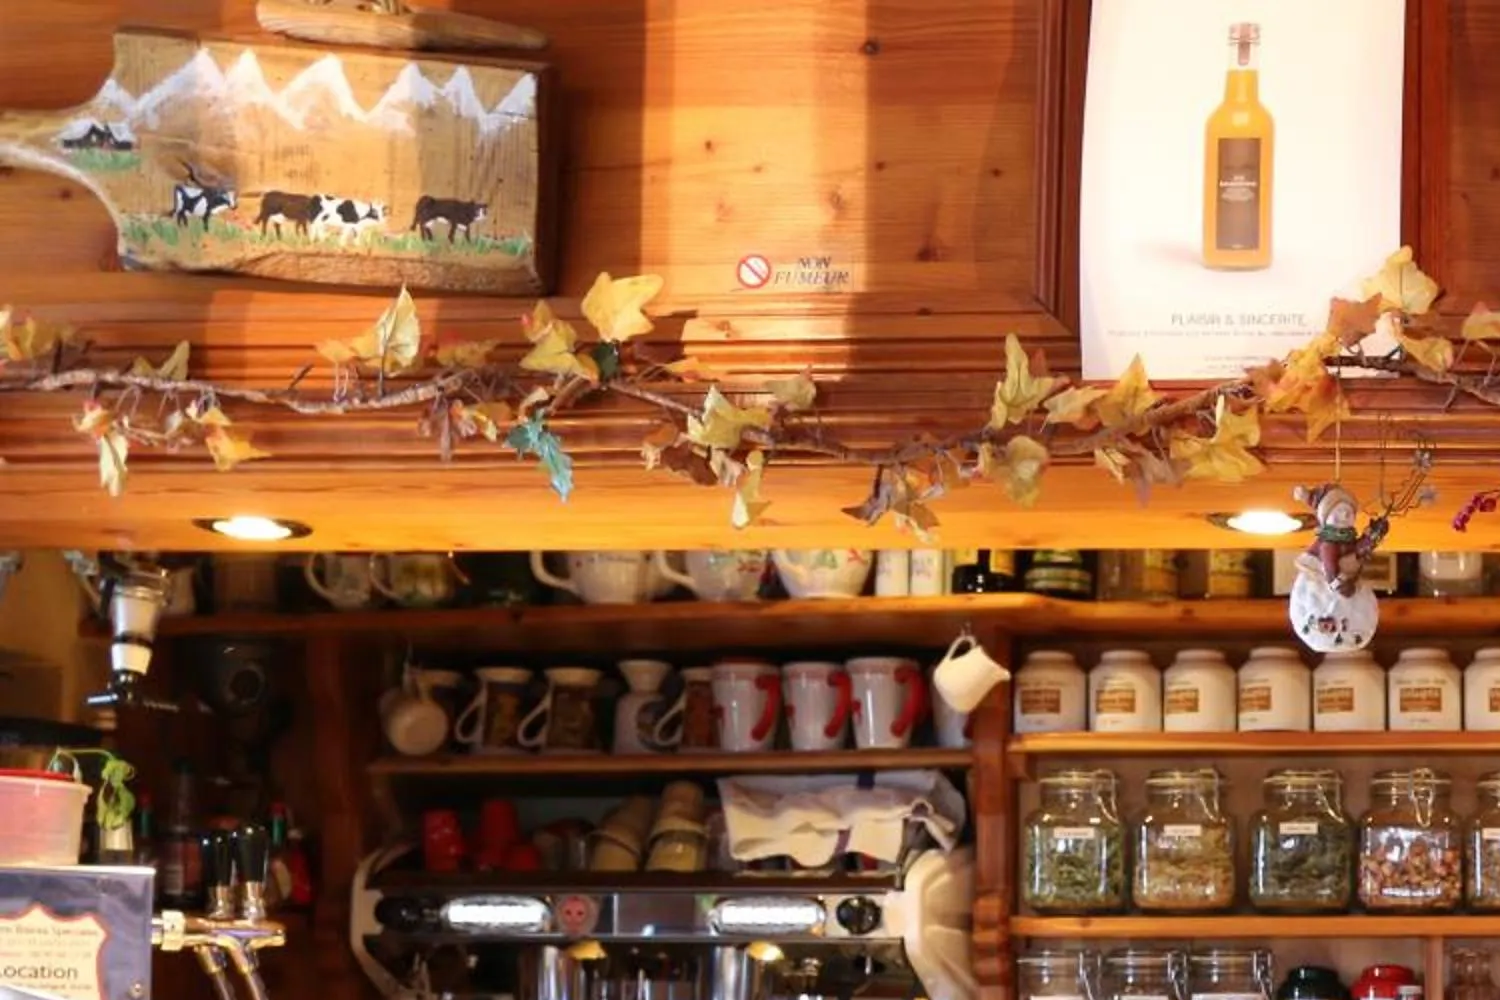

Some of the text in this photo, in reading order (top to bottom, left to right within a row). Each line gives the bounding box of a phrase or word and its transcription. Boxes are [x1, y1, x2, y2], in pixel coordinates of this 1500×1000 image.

[798, 255, 832, 269] NON
[773, 271, 849, 285] FUMEUR
[0, 965, 79, 980] ocation
